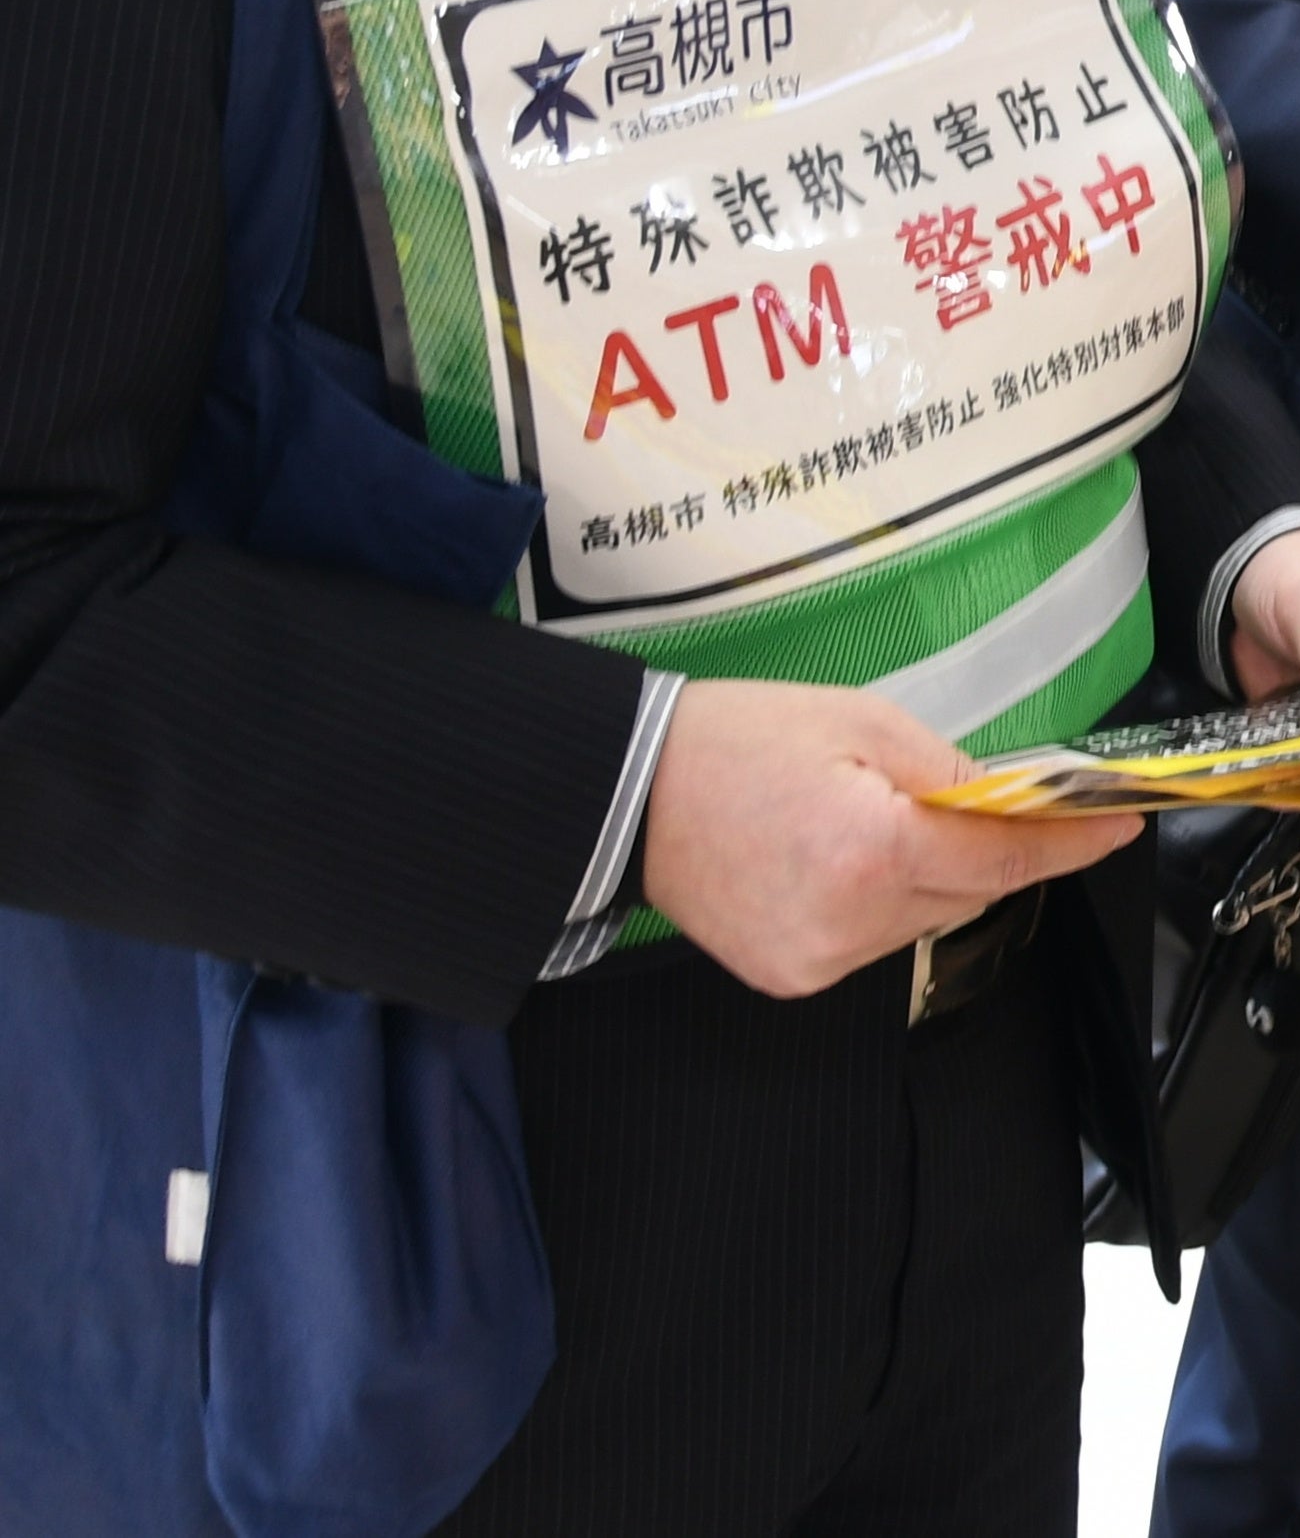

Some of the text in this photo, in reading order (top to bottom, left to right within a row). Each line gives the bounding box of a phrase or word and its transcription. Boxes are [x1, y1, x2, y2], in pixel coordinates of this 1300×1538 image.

[540, 62, 1130, 303] 特殊詐欺被害防止
[609, 72, 802, 143] Takatsuki City
[582, 152, 1157, 442] ATM 警戒中
[580, 294, 1187, 555] 高槻市 特殊詐欺被害防止 強化特別対策本部
